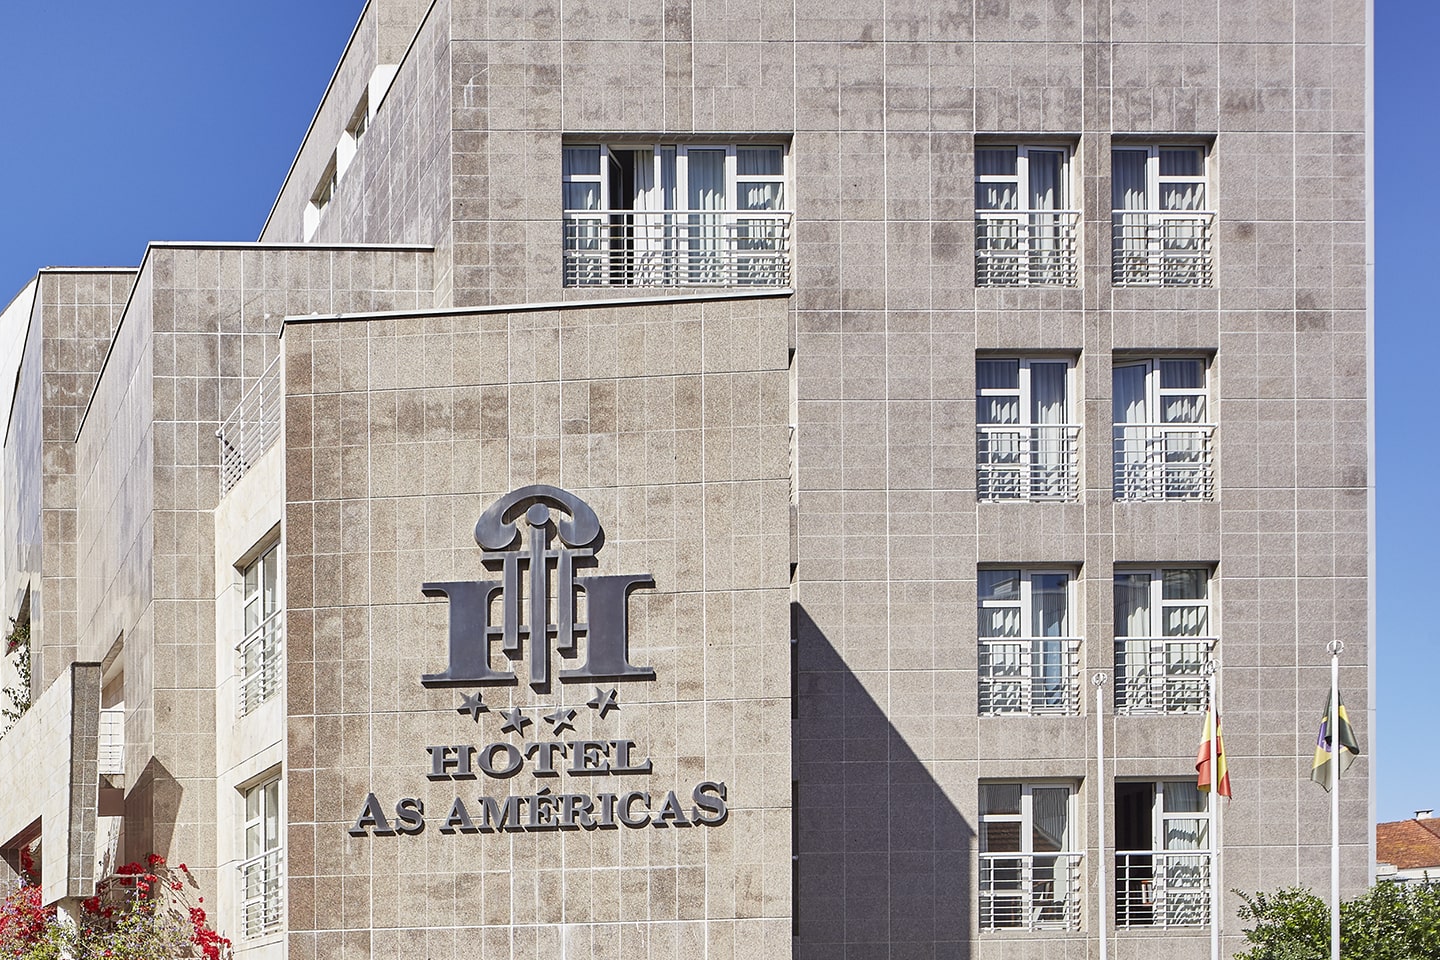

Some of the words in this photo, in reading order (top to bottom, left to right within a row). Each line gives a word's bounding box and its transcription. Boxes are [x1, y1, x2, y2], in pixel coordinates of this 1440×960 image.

[426, 739, 652, 782] HOTEL
[349, 792, 425, 837] AS
[439, 782, 728, 835] AMÉRICAS
